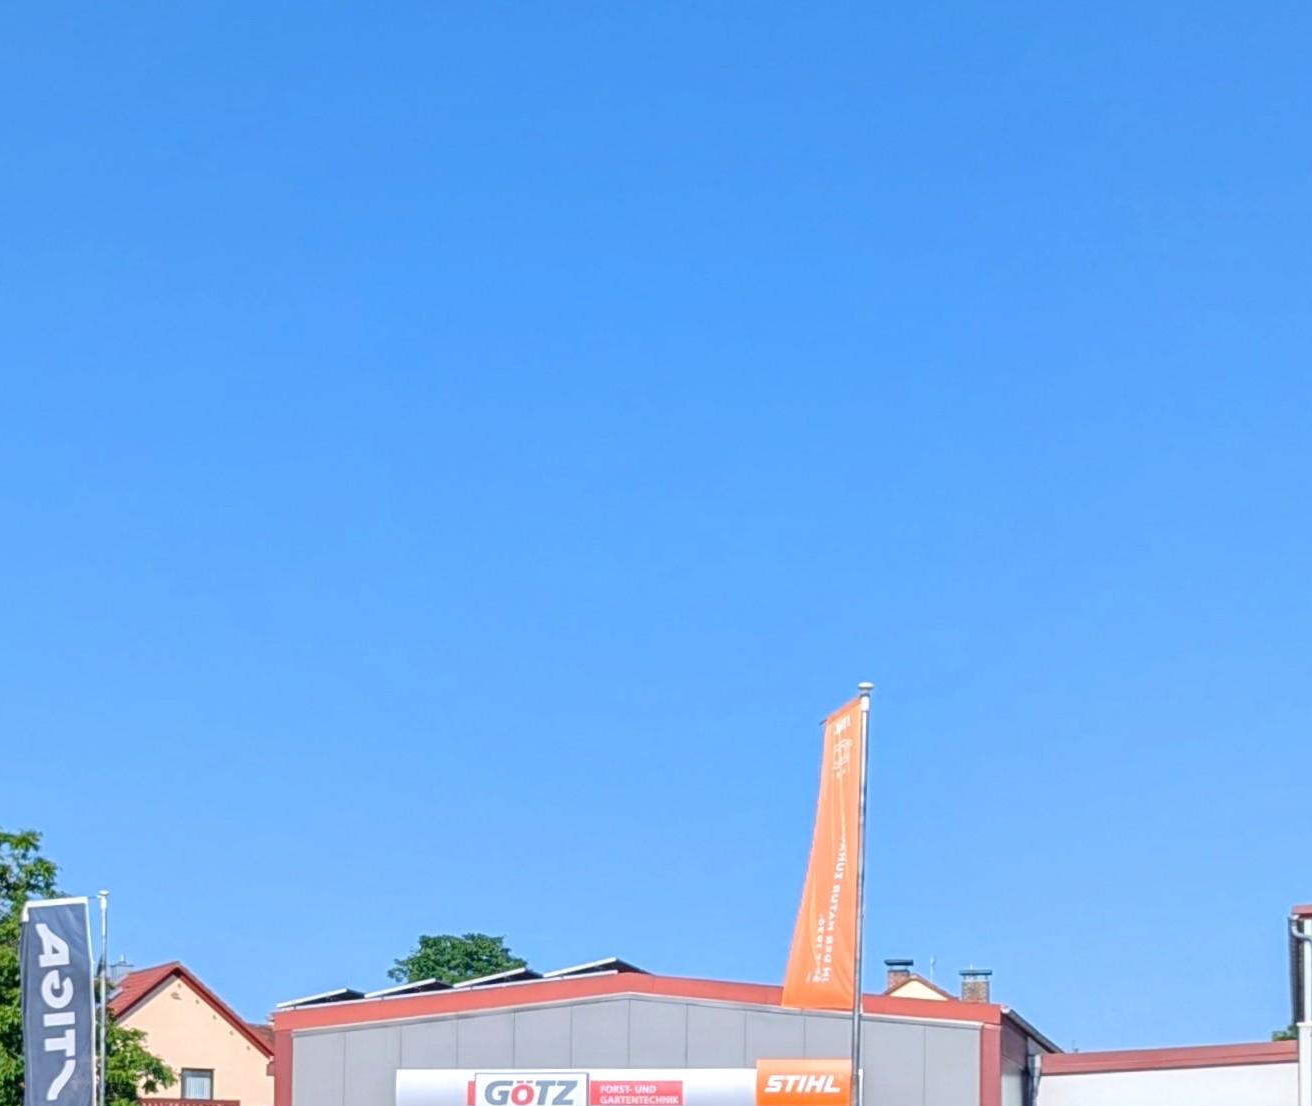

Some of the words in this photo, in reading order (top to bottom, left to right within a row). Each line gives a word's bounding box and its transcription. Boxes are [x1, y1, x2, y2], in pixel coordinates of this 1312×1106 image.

[764, 1074, 841, 1093] STIHL
[600, 1085, 632, 1095] FORST-
[635, 1085, 657, 1094] UND
[600, 1095, 679, 1105] GARTENTECHNIK
